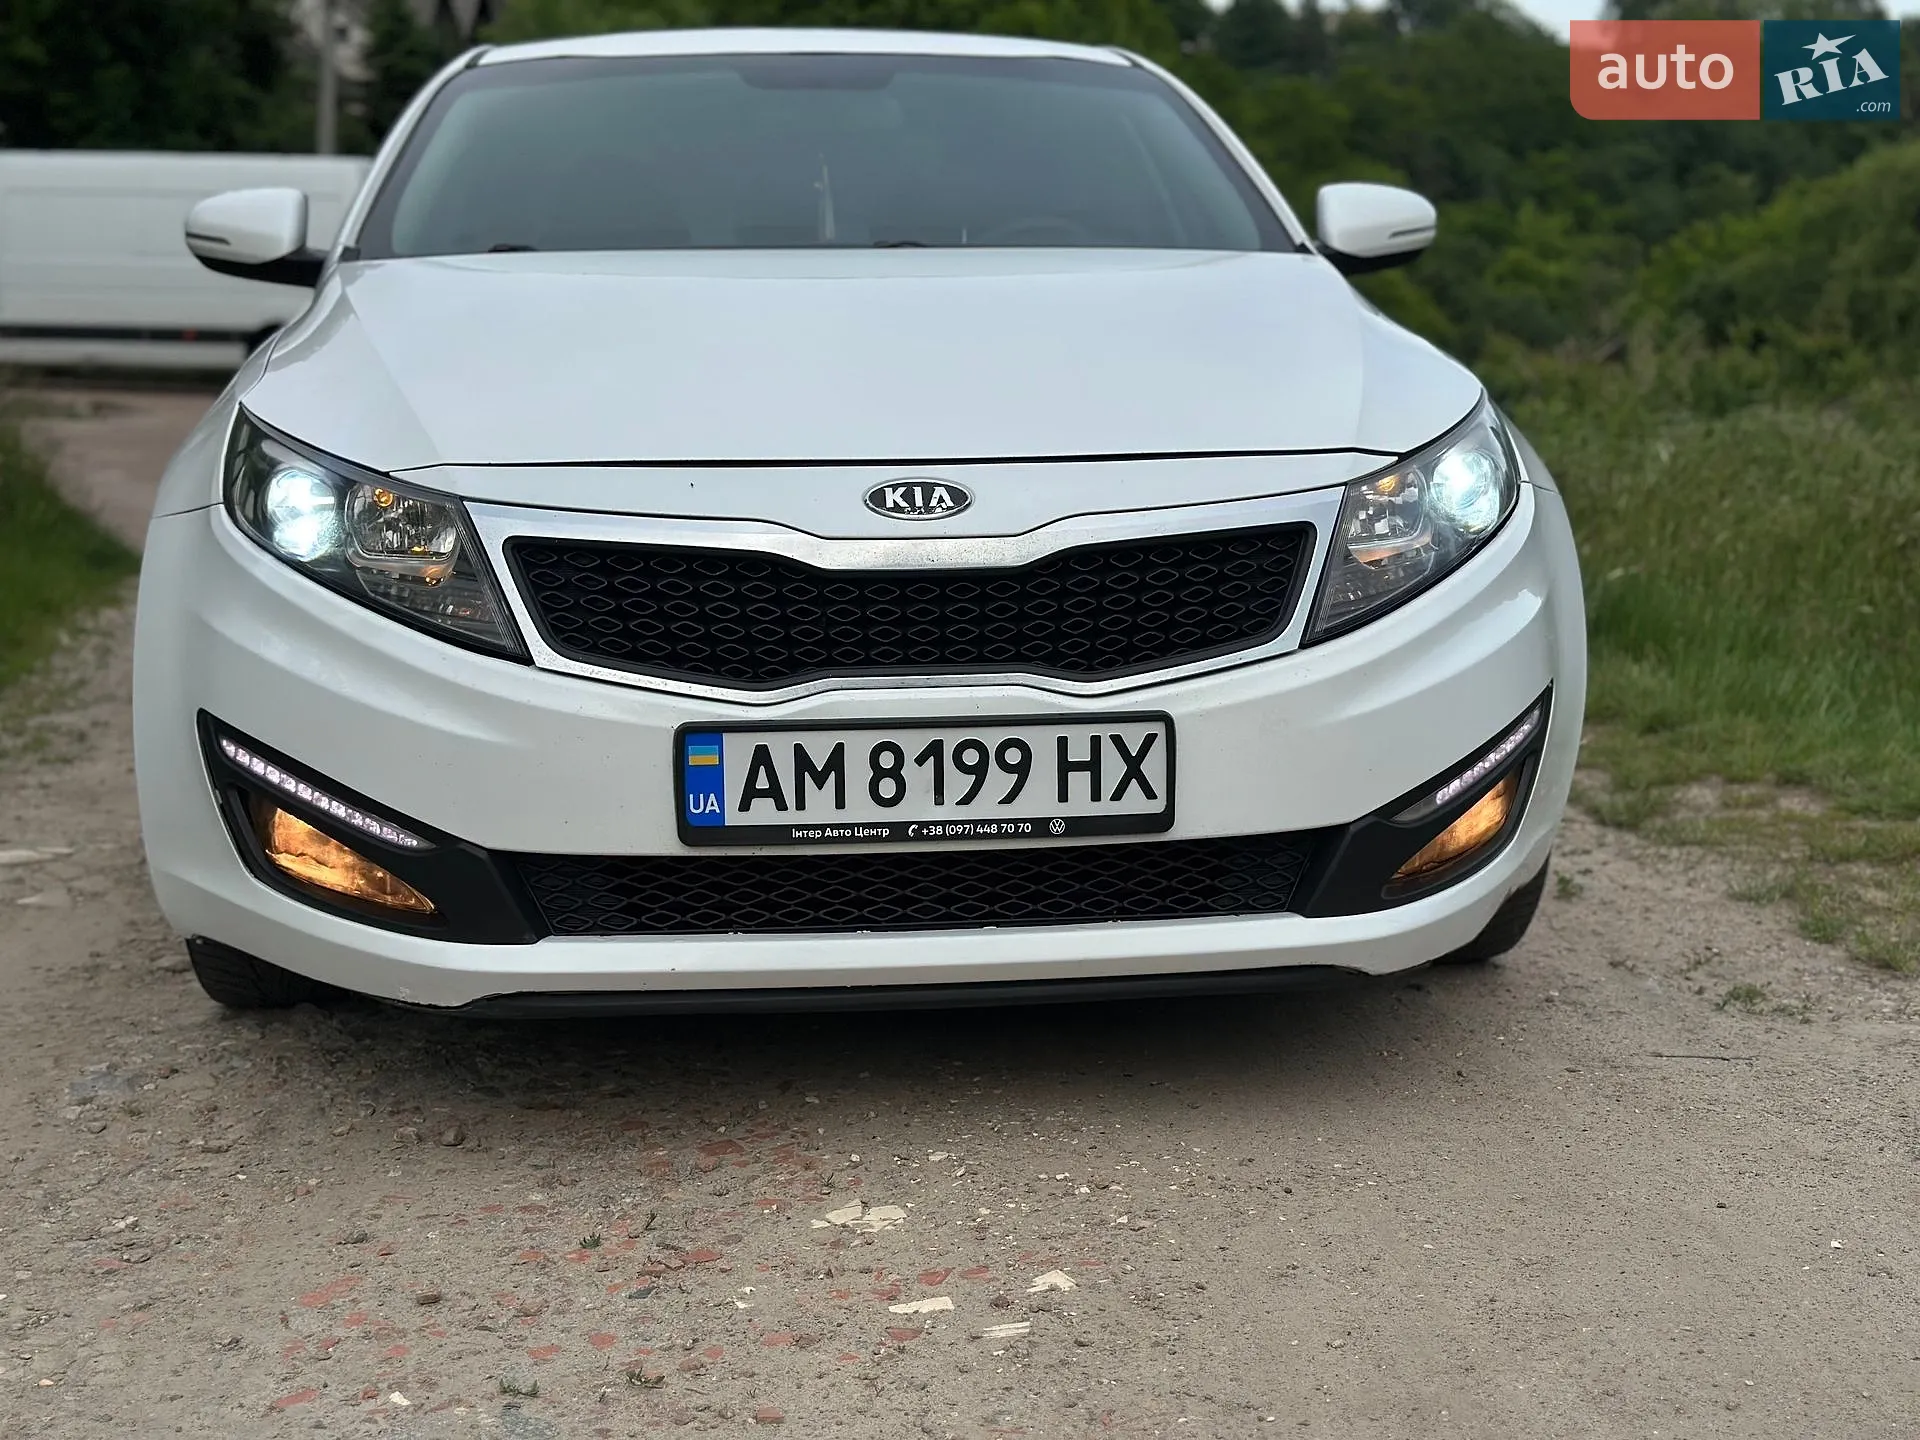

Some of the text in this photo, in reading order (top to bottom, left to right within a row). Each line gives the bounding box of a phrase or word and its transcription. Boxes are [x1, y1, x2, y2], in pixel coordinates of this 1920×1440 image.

[883, 486, 955, 508] KIA
[738, 732, 1159, 812] AM 8199 HX
[689, 793, 720, 814] UA
[792, 826, 890, 839] Інтер Авто Центр
[921, 822, 1032, 836] +38 (097) 448 70 70
